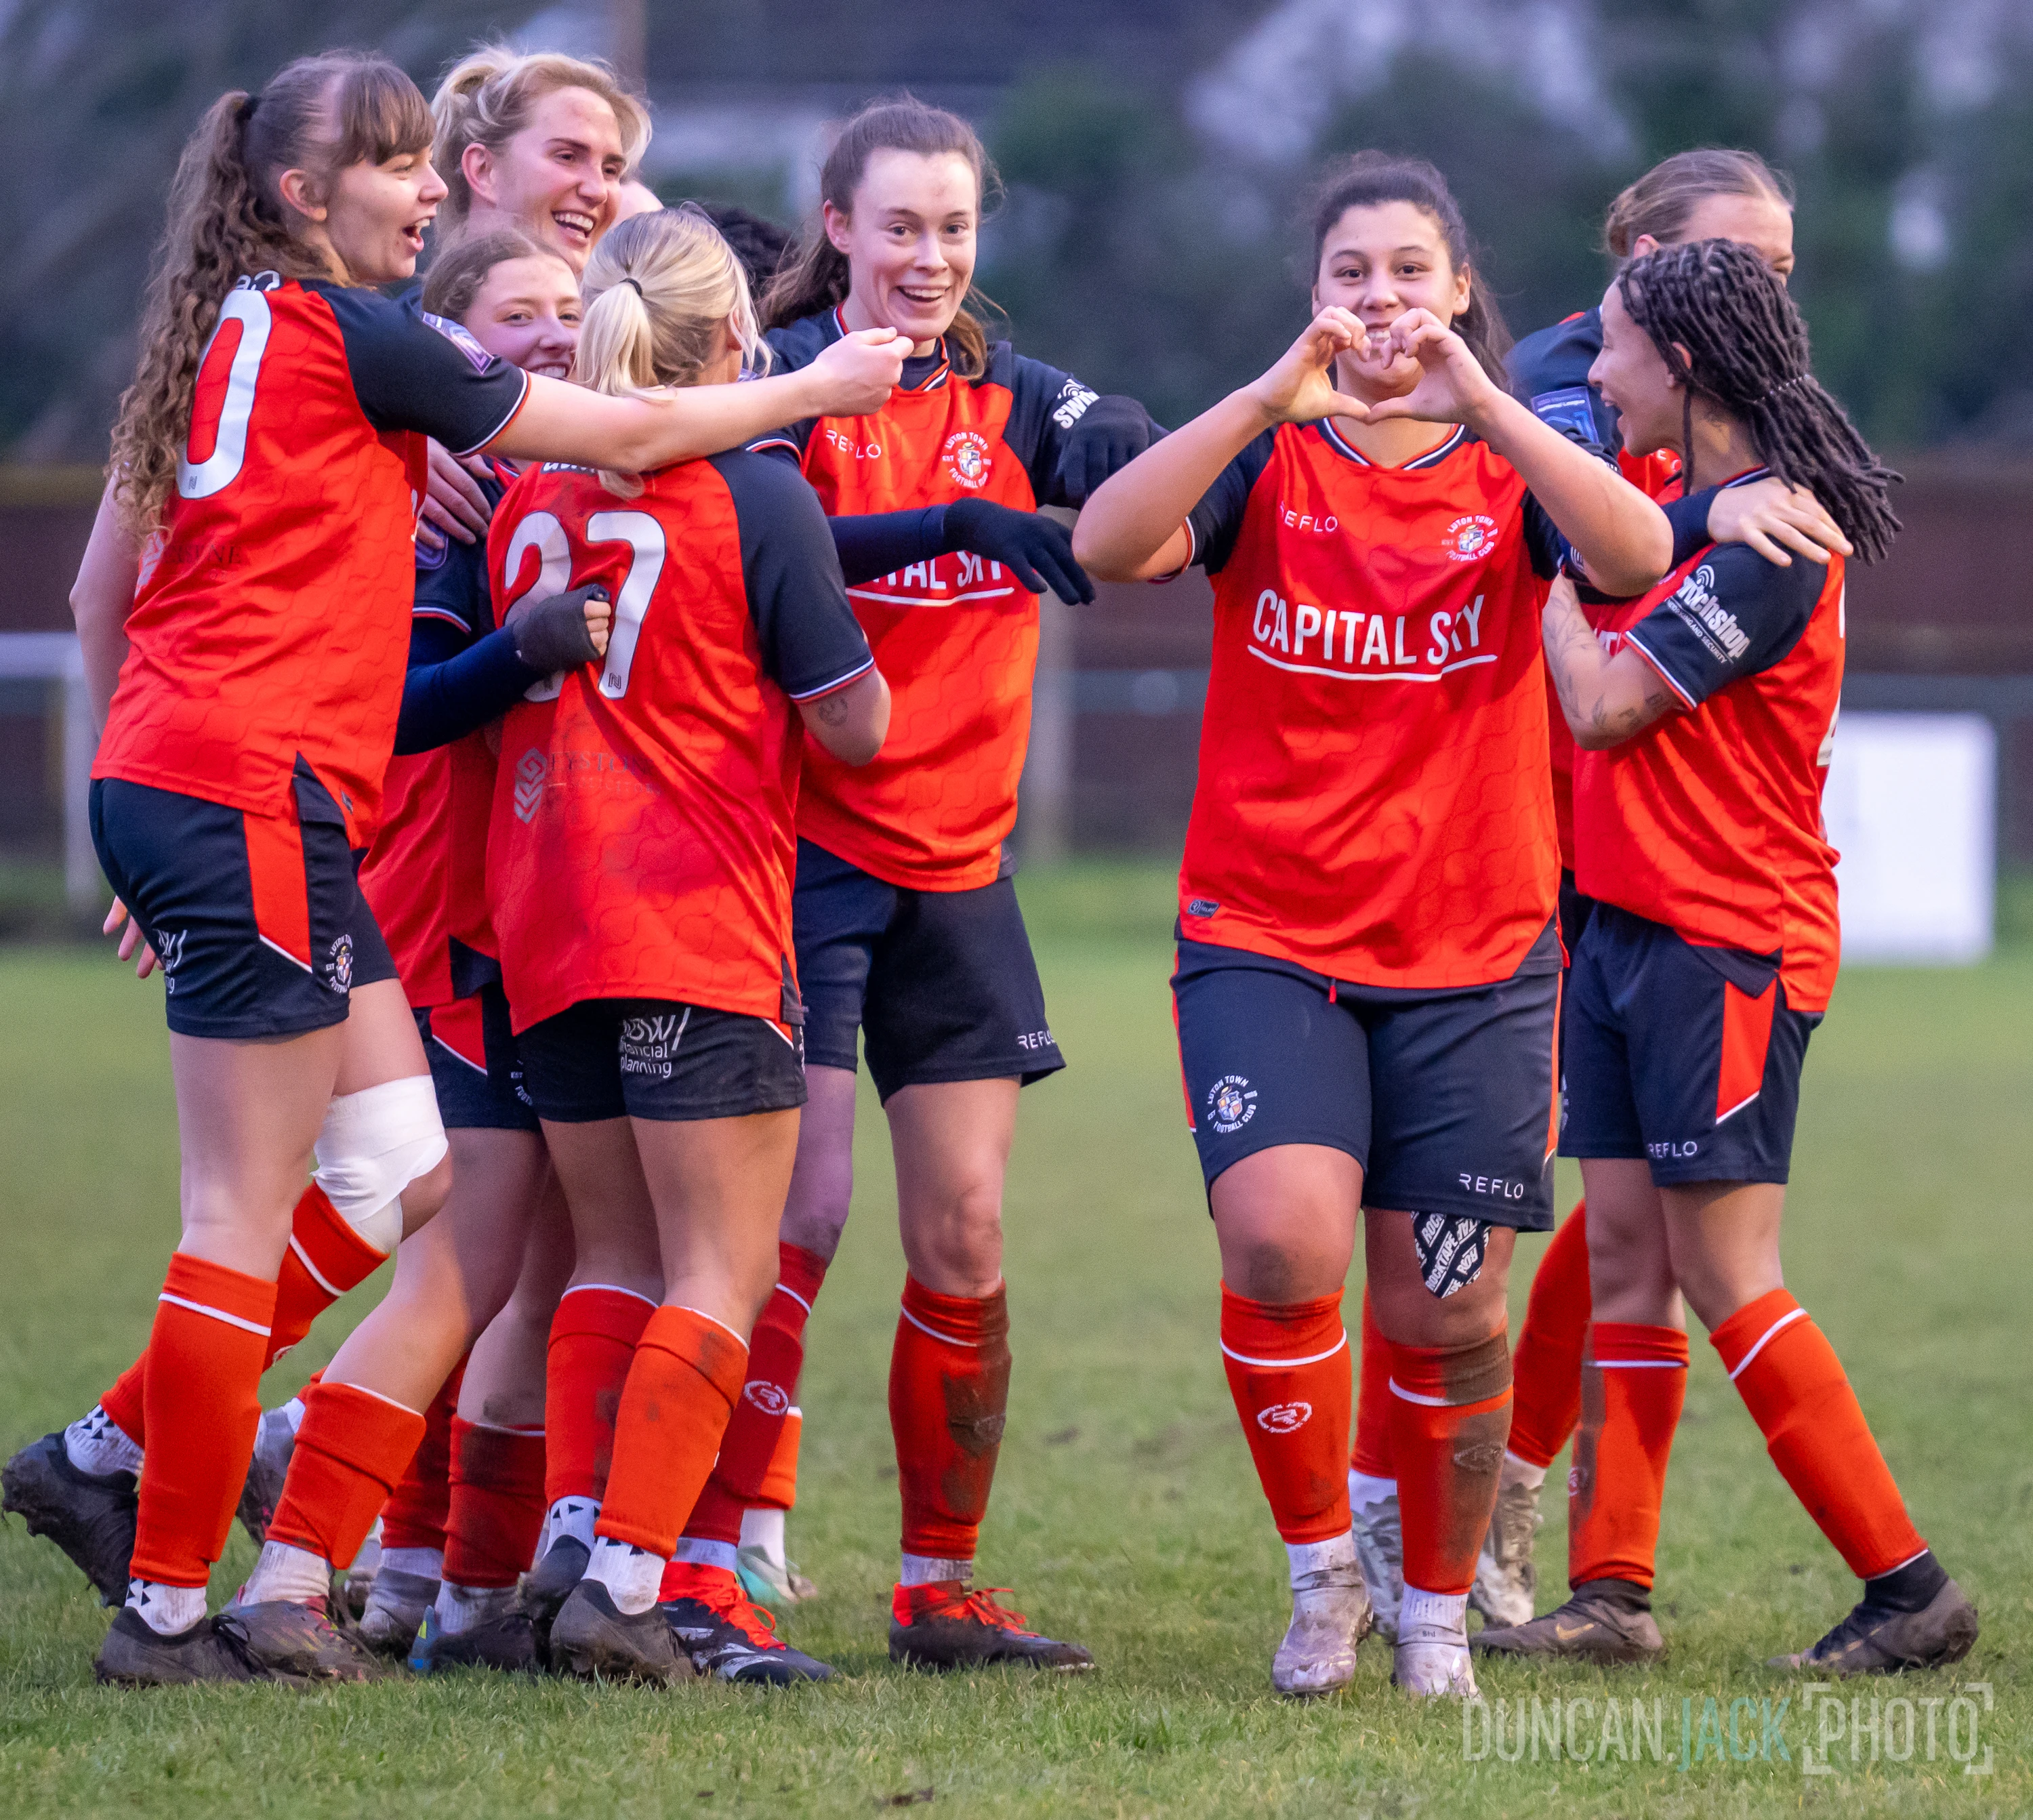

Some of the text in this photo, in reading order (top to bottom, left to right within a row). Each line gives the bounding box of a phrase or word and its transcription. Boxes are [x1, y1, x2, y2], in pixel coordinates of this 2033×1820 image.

[504, 510, 666, 703] 27
[1254, 589, 1418, 665] CAPITAL
[1207, 1075, 1249, 1104] LUTON TOWN
[1459, 1173, 1524, 1200] REFLO
[1425, 1233, 1458, 1291] ROCKTAPE
